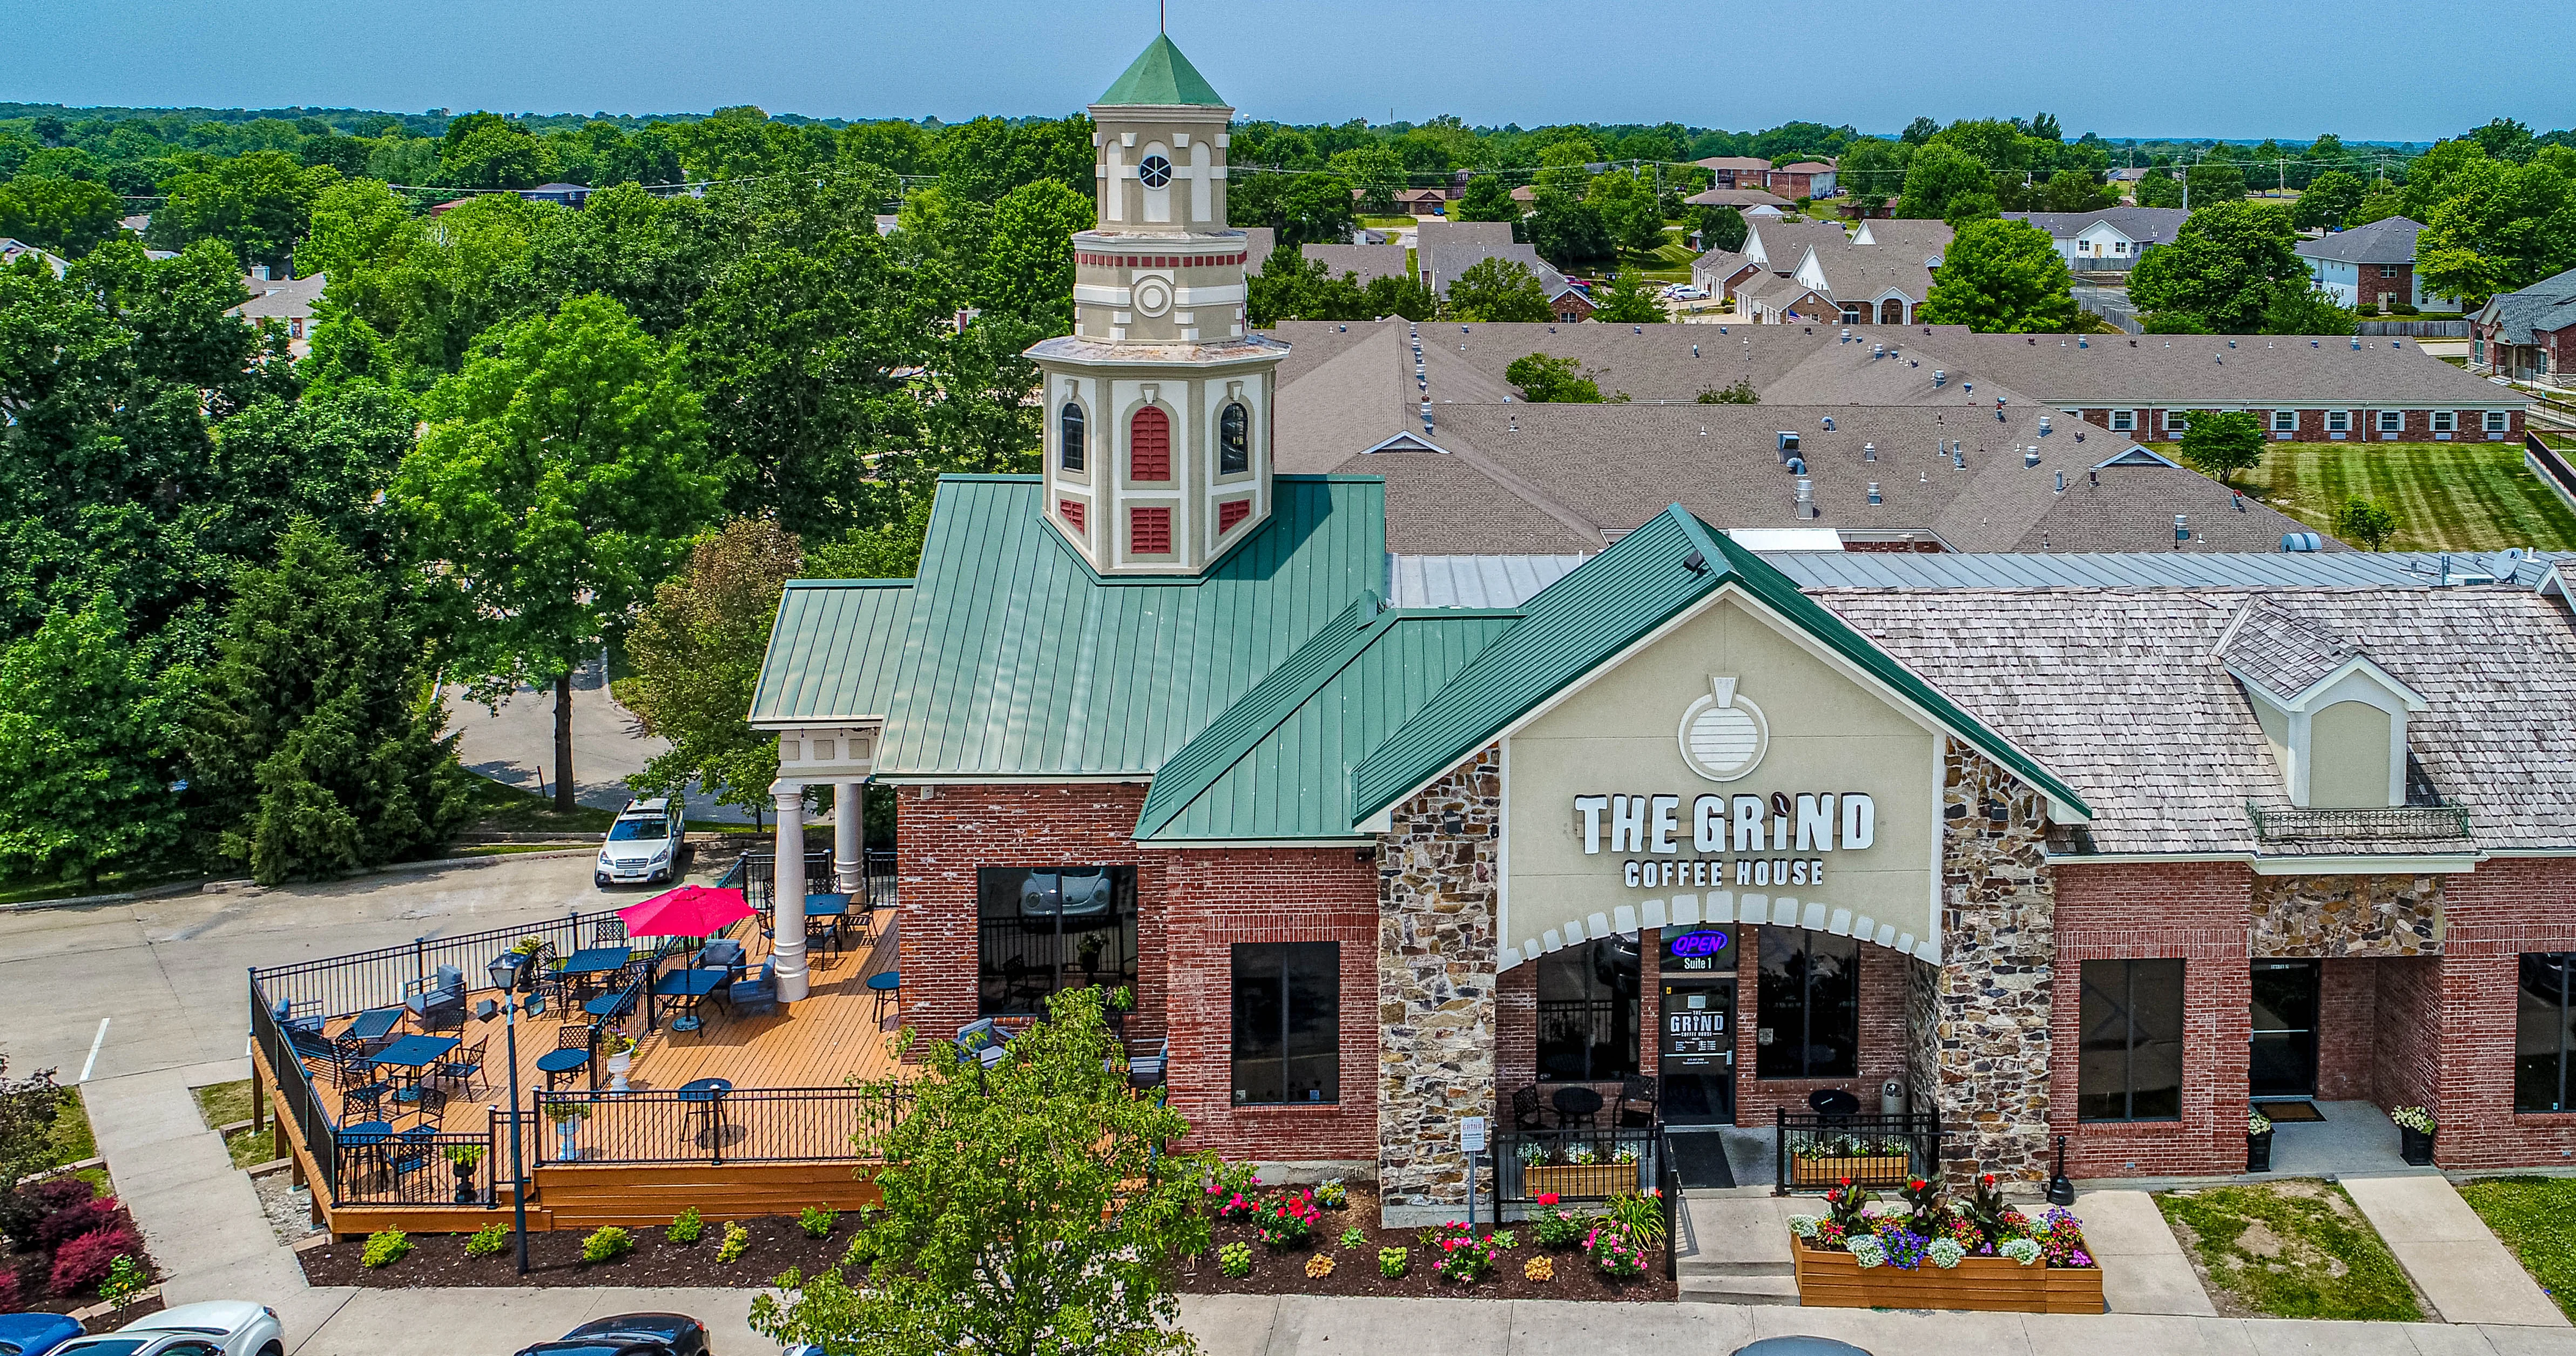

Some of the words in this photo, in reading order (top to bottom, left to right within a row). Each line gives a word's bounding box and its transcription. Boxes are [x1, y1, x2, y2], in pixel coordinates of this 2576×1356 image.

[1574, 793, 1680, 854] THE
[1623, 859, 1723, 888] COFFEE
[1736, 858, 1823, 886] HOUSE
[1676, 936, 1722, 952] OPEN
[1684, 957, 1705, 969] Suite
[1708, 957, 1711, 969] 1
